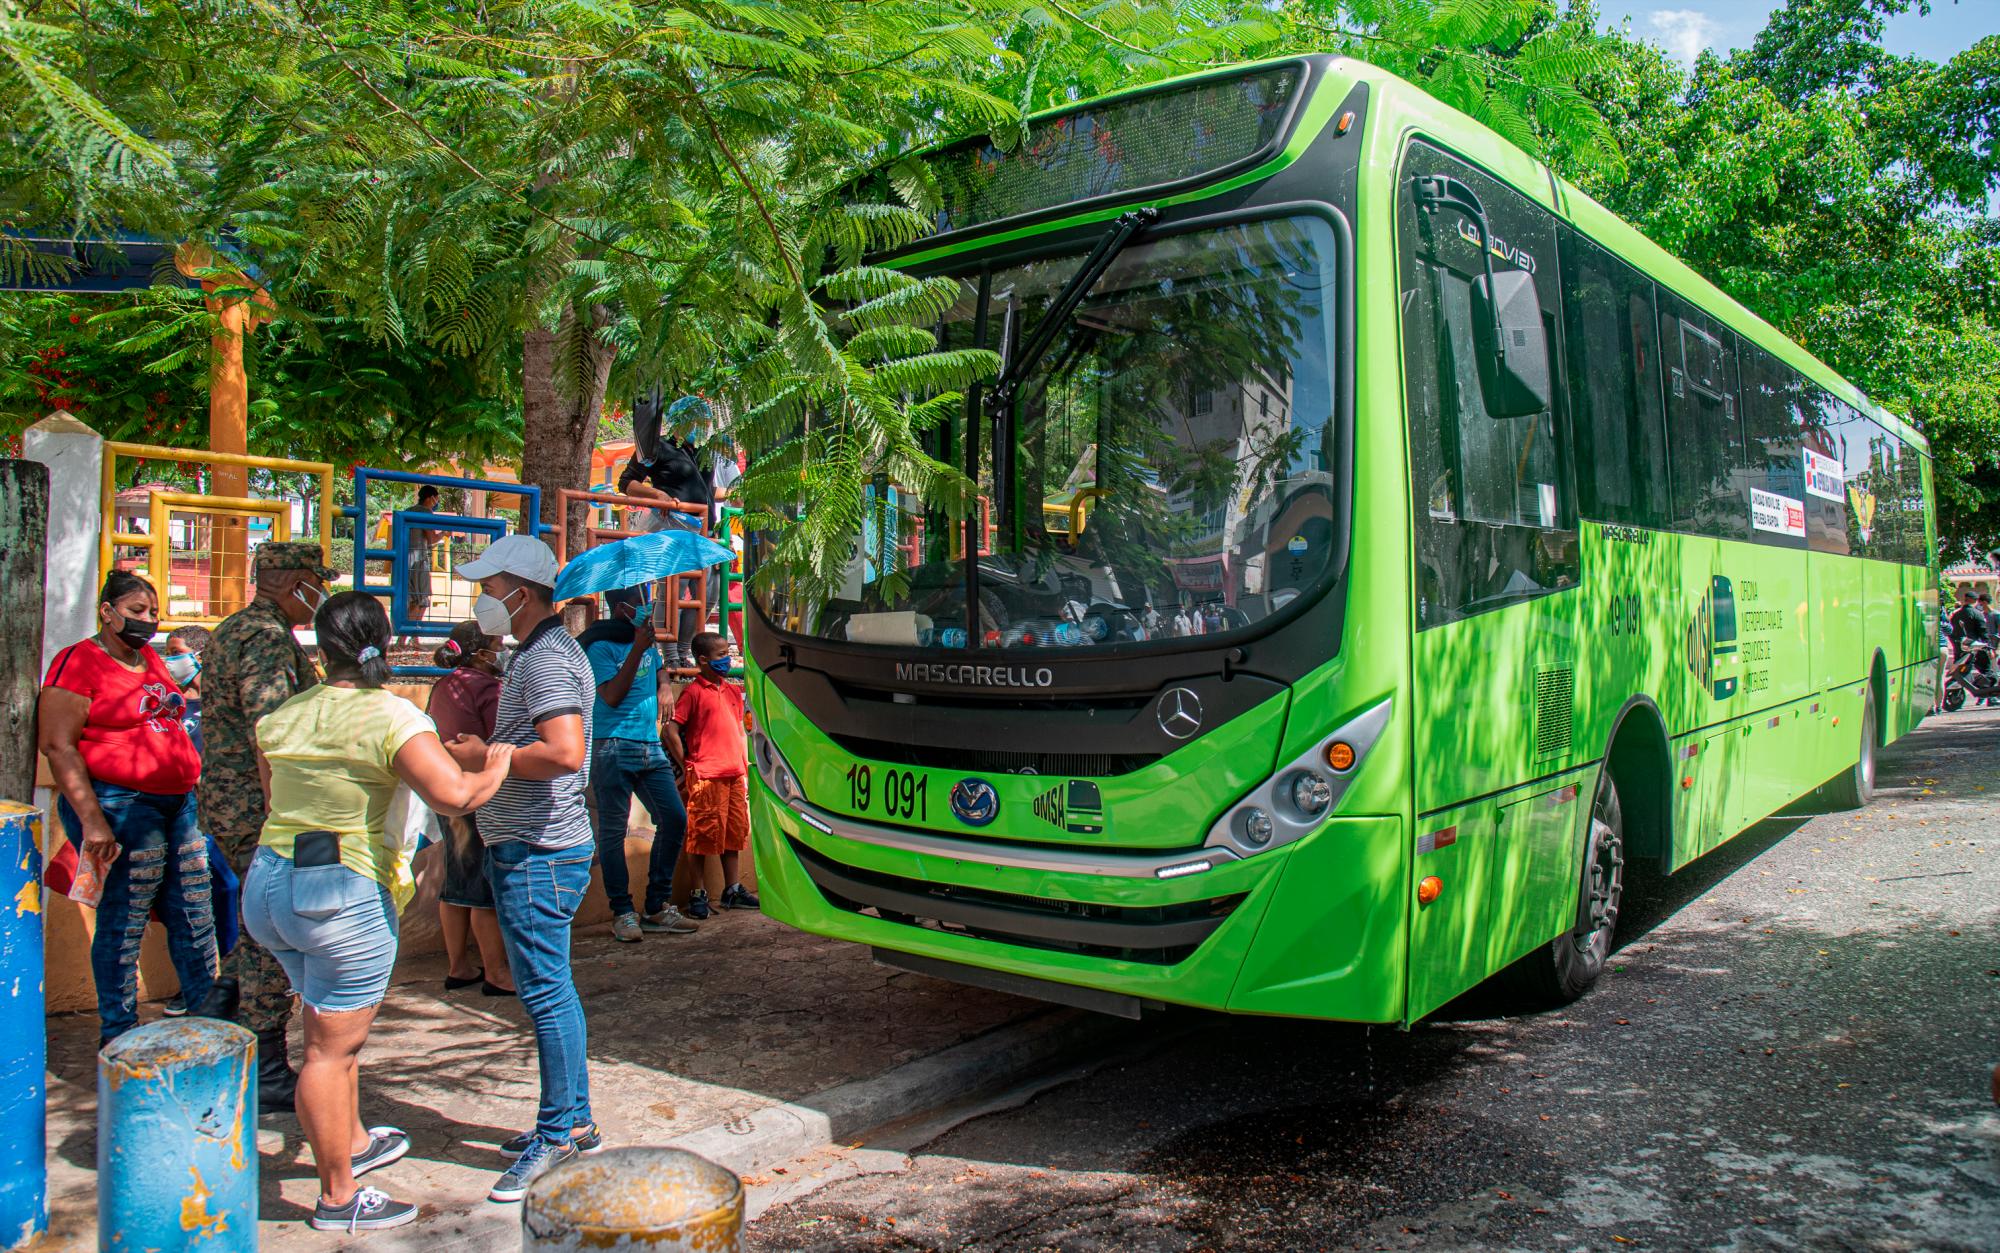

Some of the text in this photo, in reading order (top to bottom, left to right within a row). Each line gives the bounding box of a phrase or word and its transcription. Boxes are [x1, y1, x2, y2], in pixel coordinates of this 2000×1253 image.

[1610, 594, 1641, 637] 19 091
[1687, 586, 1713, 697] OMSA
[896, 663, 1053, 687] MASCARELLO
[847, 763, 928, 822] 19 091
[1033, 783, 1066, 830] OMSA
